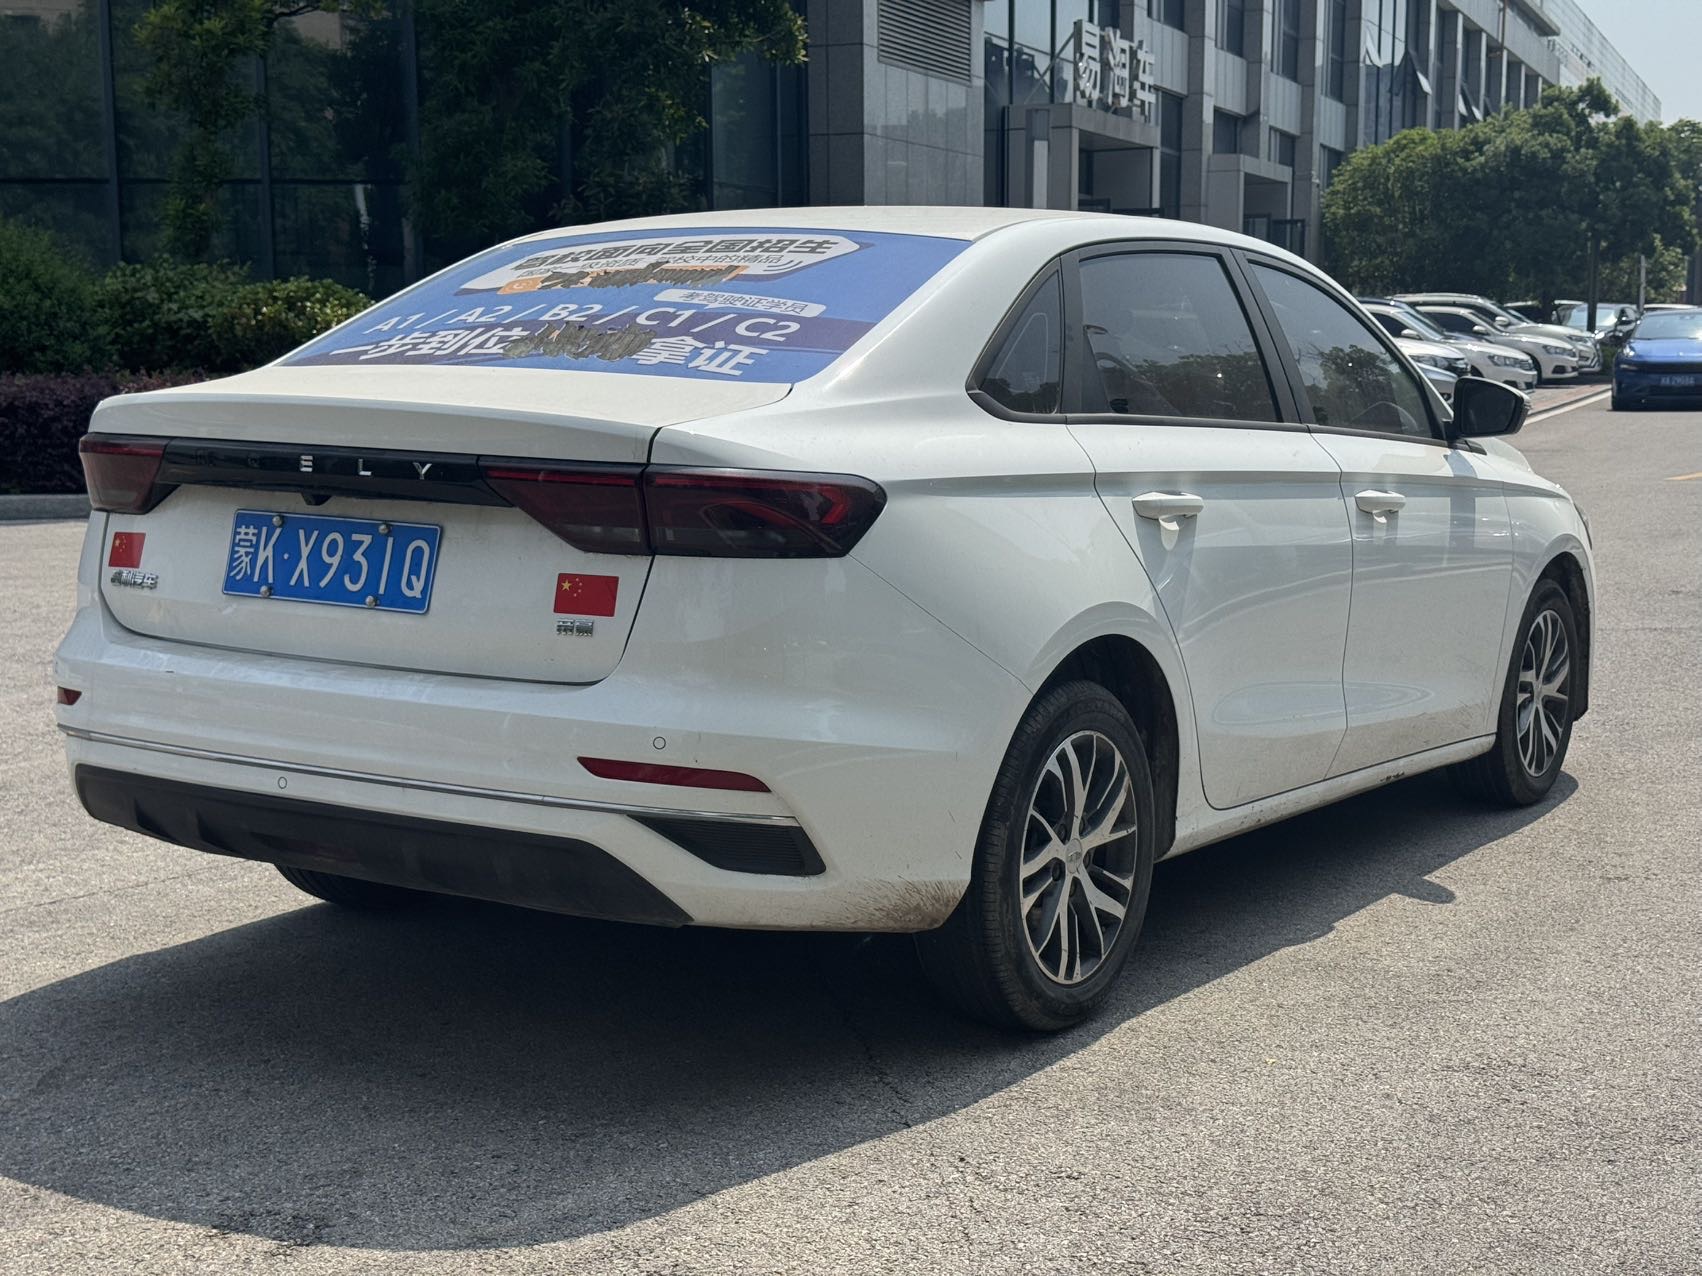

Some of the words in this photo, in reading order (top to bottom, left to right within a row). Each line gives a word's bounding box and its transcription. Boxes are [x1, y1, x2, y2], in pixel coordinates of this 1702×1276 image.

[511, 240, 839, 270] 驾校面向全国招生
[363, 313, 425, 334] A1
[446, 305, 513, 324] A2
[538, 303, 604, 321] B2
[635, 307, 697, 328] C1
[734, 317, 801, 341] C2
[632, 335, 770, 376] 拿证
